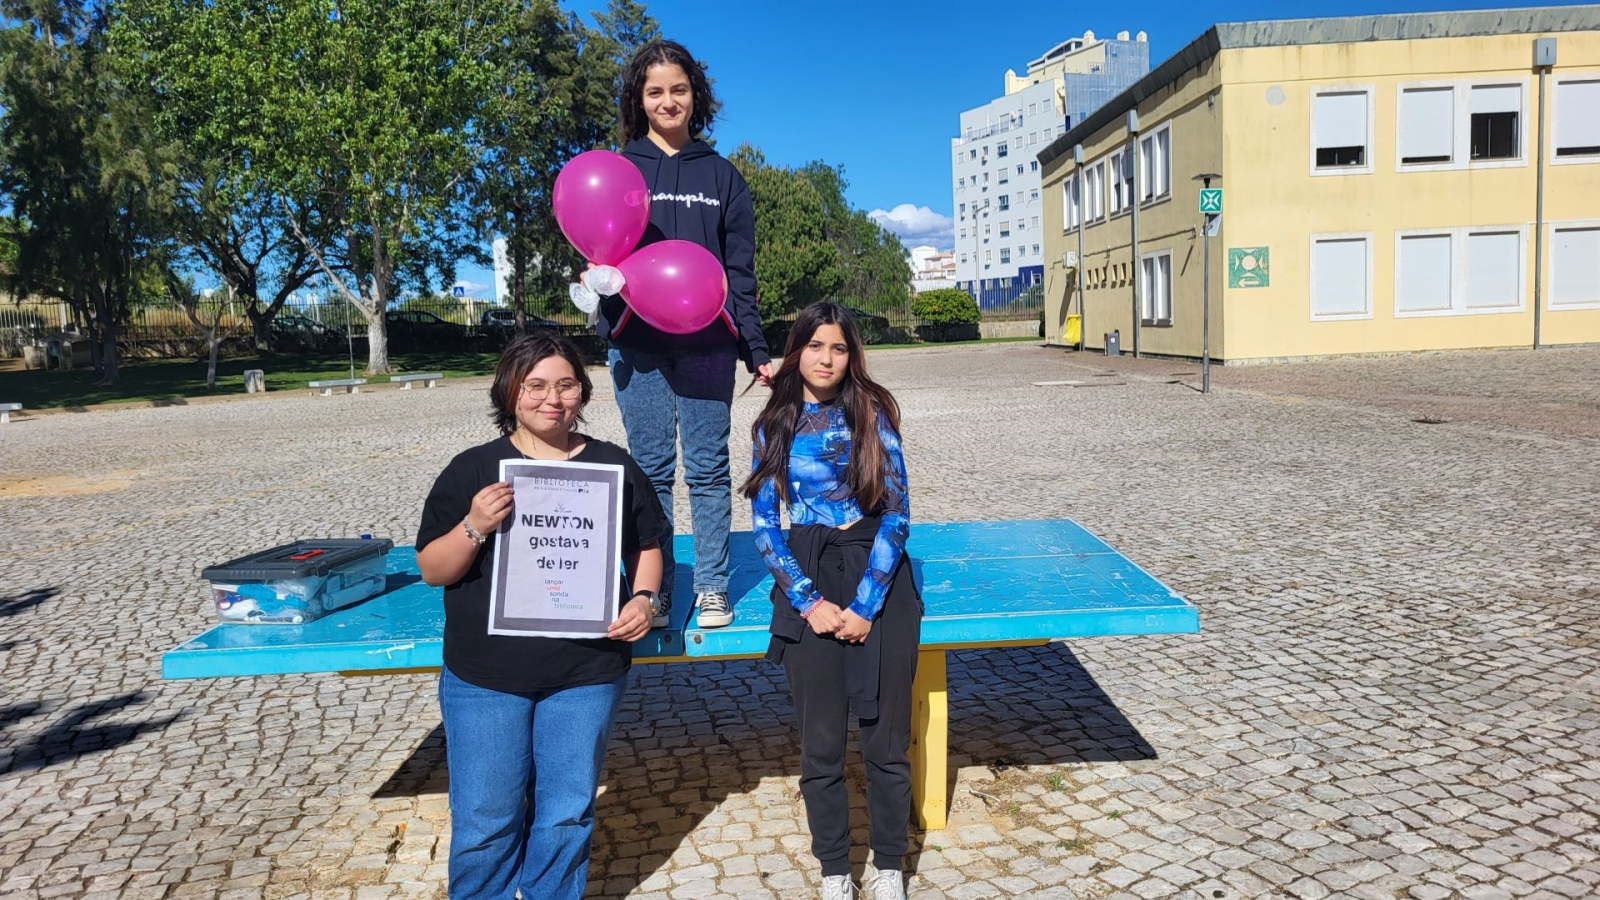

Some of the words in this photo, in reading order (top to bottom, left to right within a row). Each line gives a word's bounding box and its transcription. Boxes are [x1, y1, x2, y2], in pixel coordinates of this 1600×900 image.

[534, 478, 590, 488] BIBLIOTECA
[521, 514, 594, 530] NEWTON
[529, 536, 589, 550] gostava
[537, 556, 555, 569] de
[559, 557, 579, 570] ler
